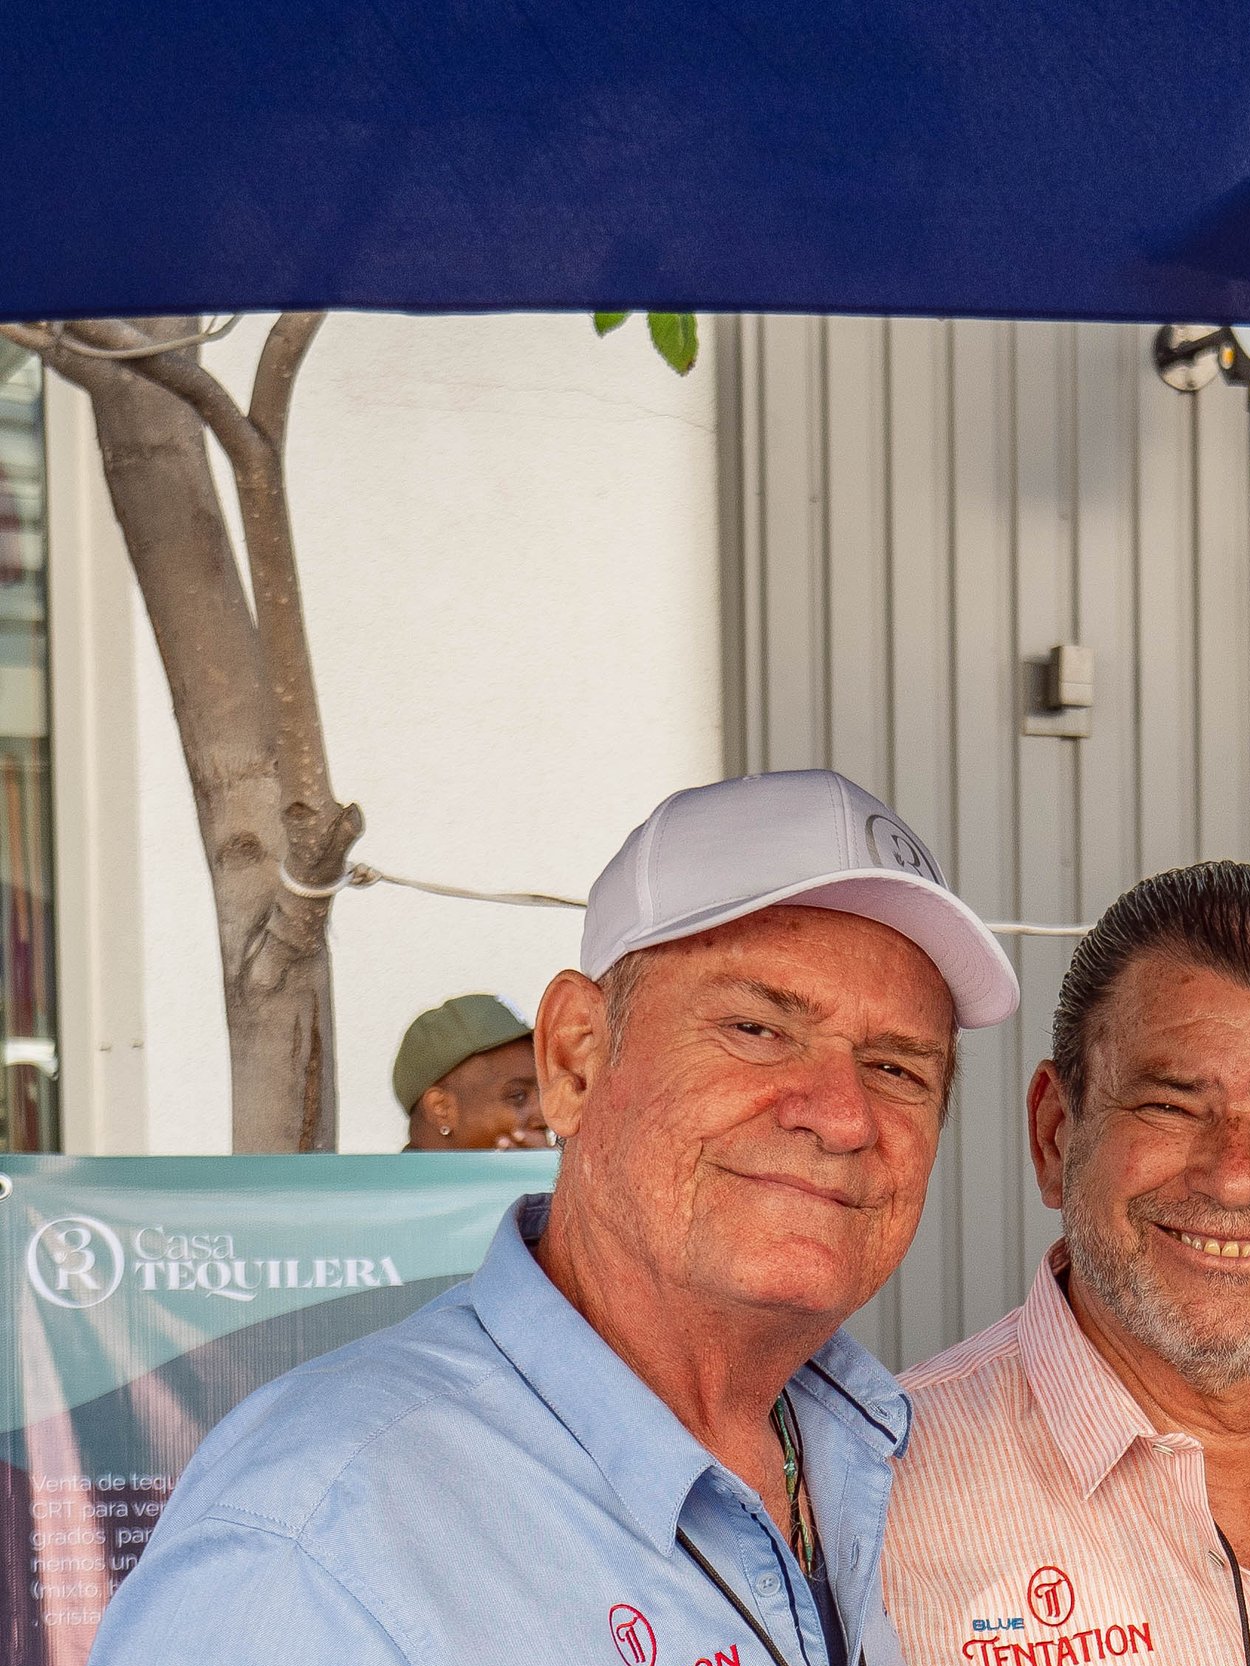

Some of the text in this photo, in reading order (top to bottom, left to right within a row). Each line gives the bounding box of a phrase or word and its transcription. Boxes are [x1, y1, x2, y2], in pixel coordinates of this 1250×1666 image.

[135, 1226, 235, 1260] Casa
[134, 1255, 403, 1301] TEQUILERA
[32, 1474, 92, 1492] Venta
[98, 1473, 126, 1491] de
[32, 1501, 76, 1519] CRT
[82, 1504, 128, 1521] para
[32, 1527, 106, 1551] grados
[33, 1558, 106, 1574] nemos
[972, 1617, 1025, 1632] BLUE
